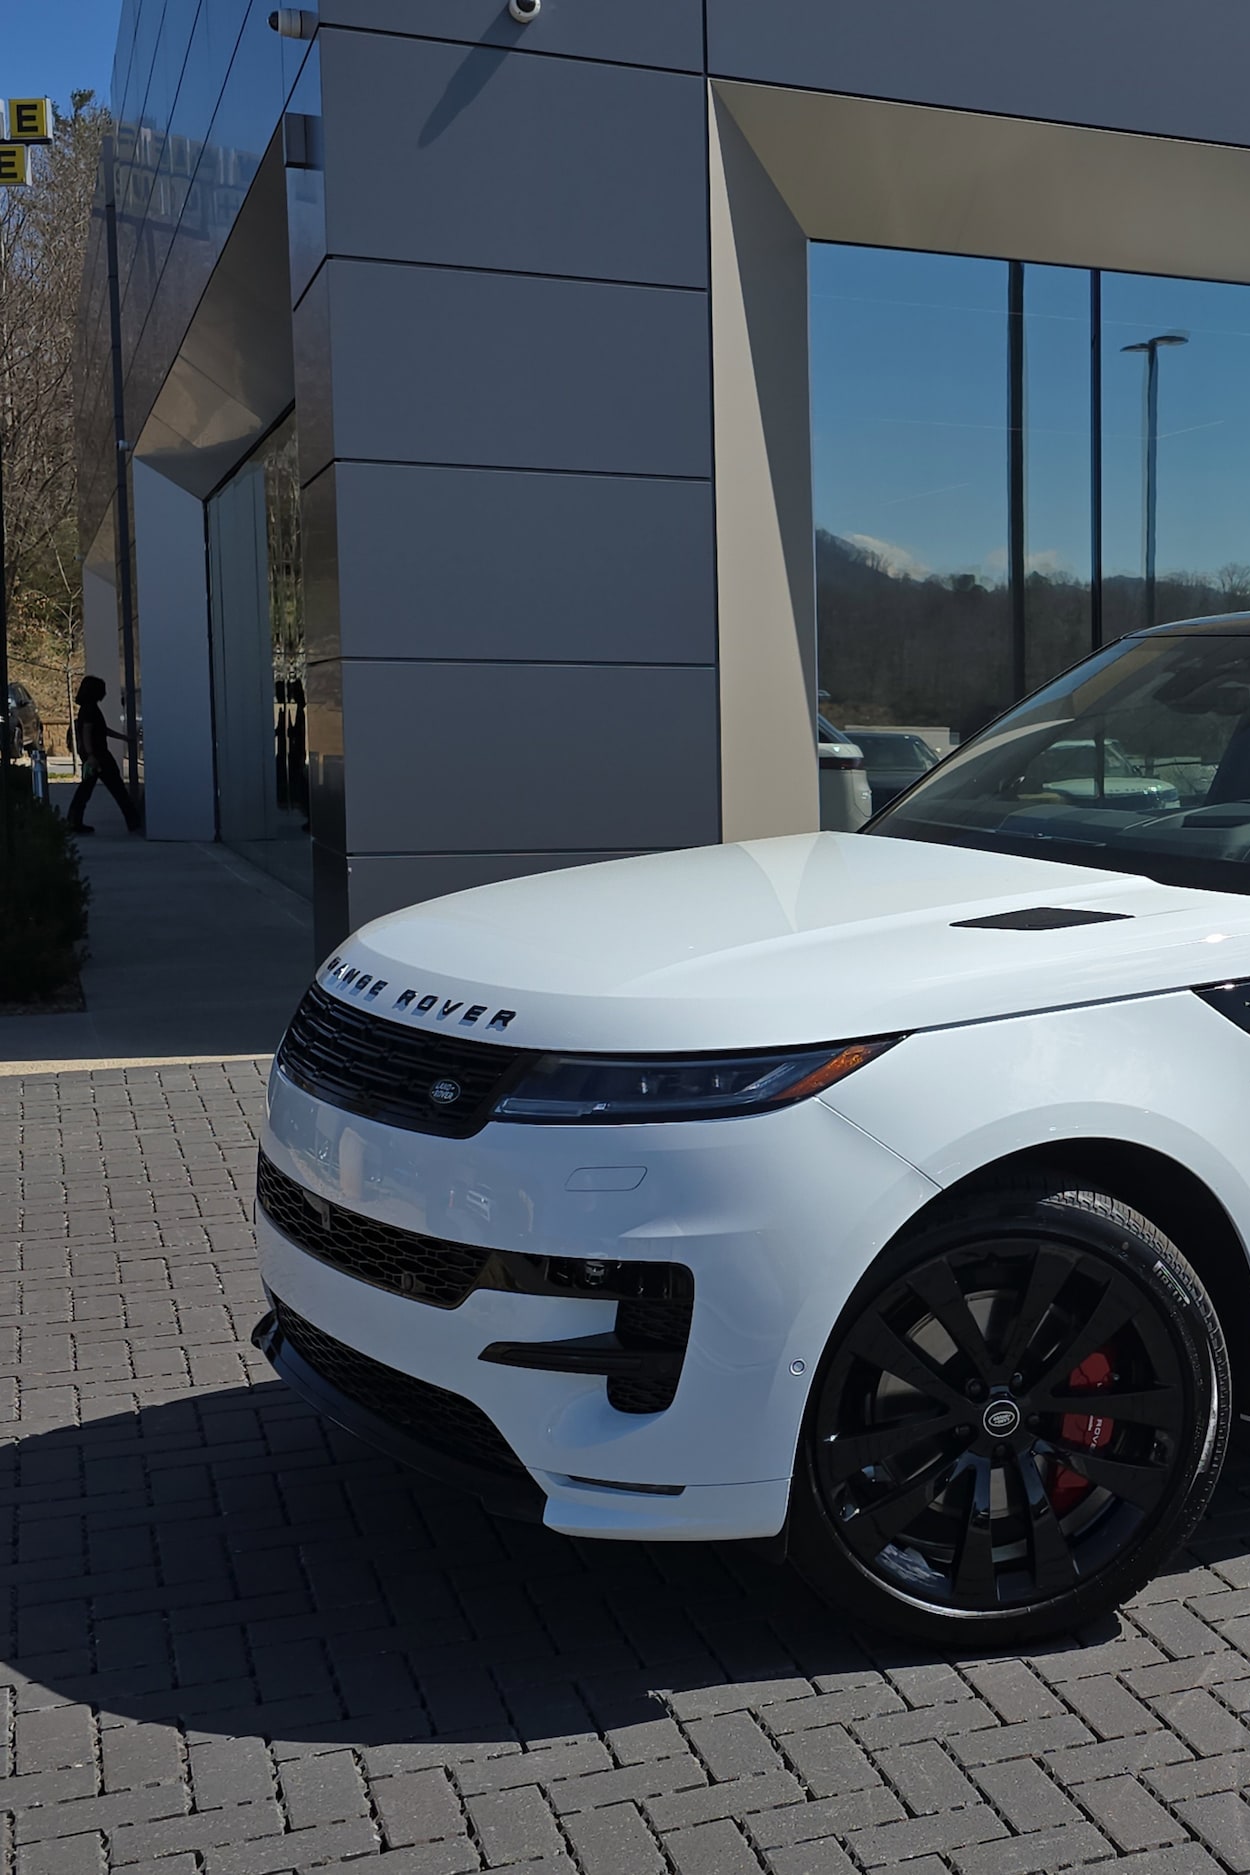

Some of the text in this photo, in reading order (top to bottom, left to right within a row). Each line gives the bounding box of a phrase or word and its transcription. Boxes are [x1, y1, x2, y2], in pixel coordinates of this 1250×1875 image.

[327, 956, 517, 1028] RANGE ROVER
[1090, 1418, 1103, 1450] ROVE
